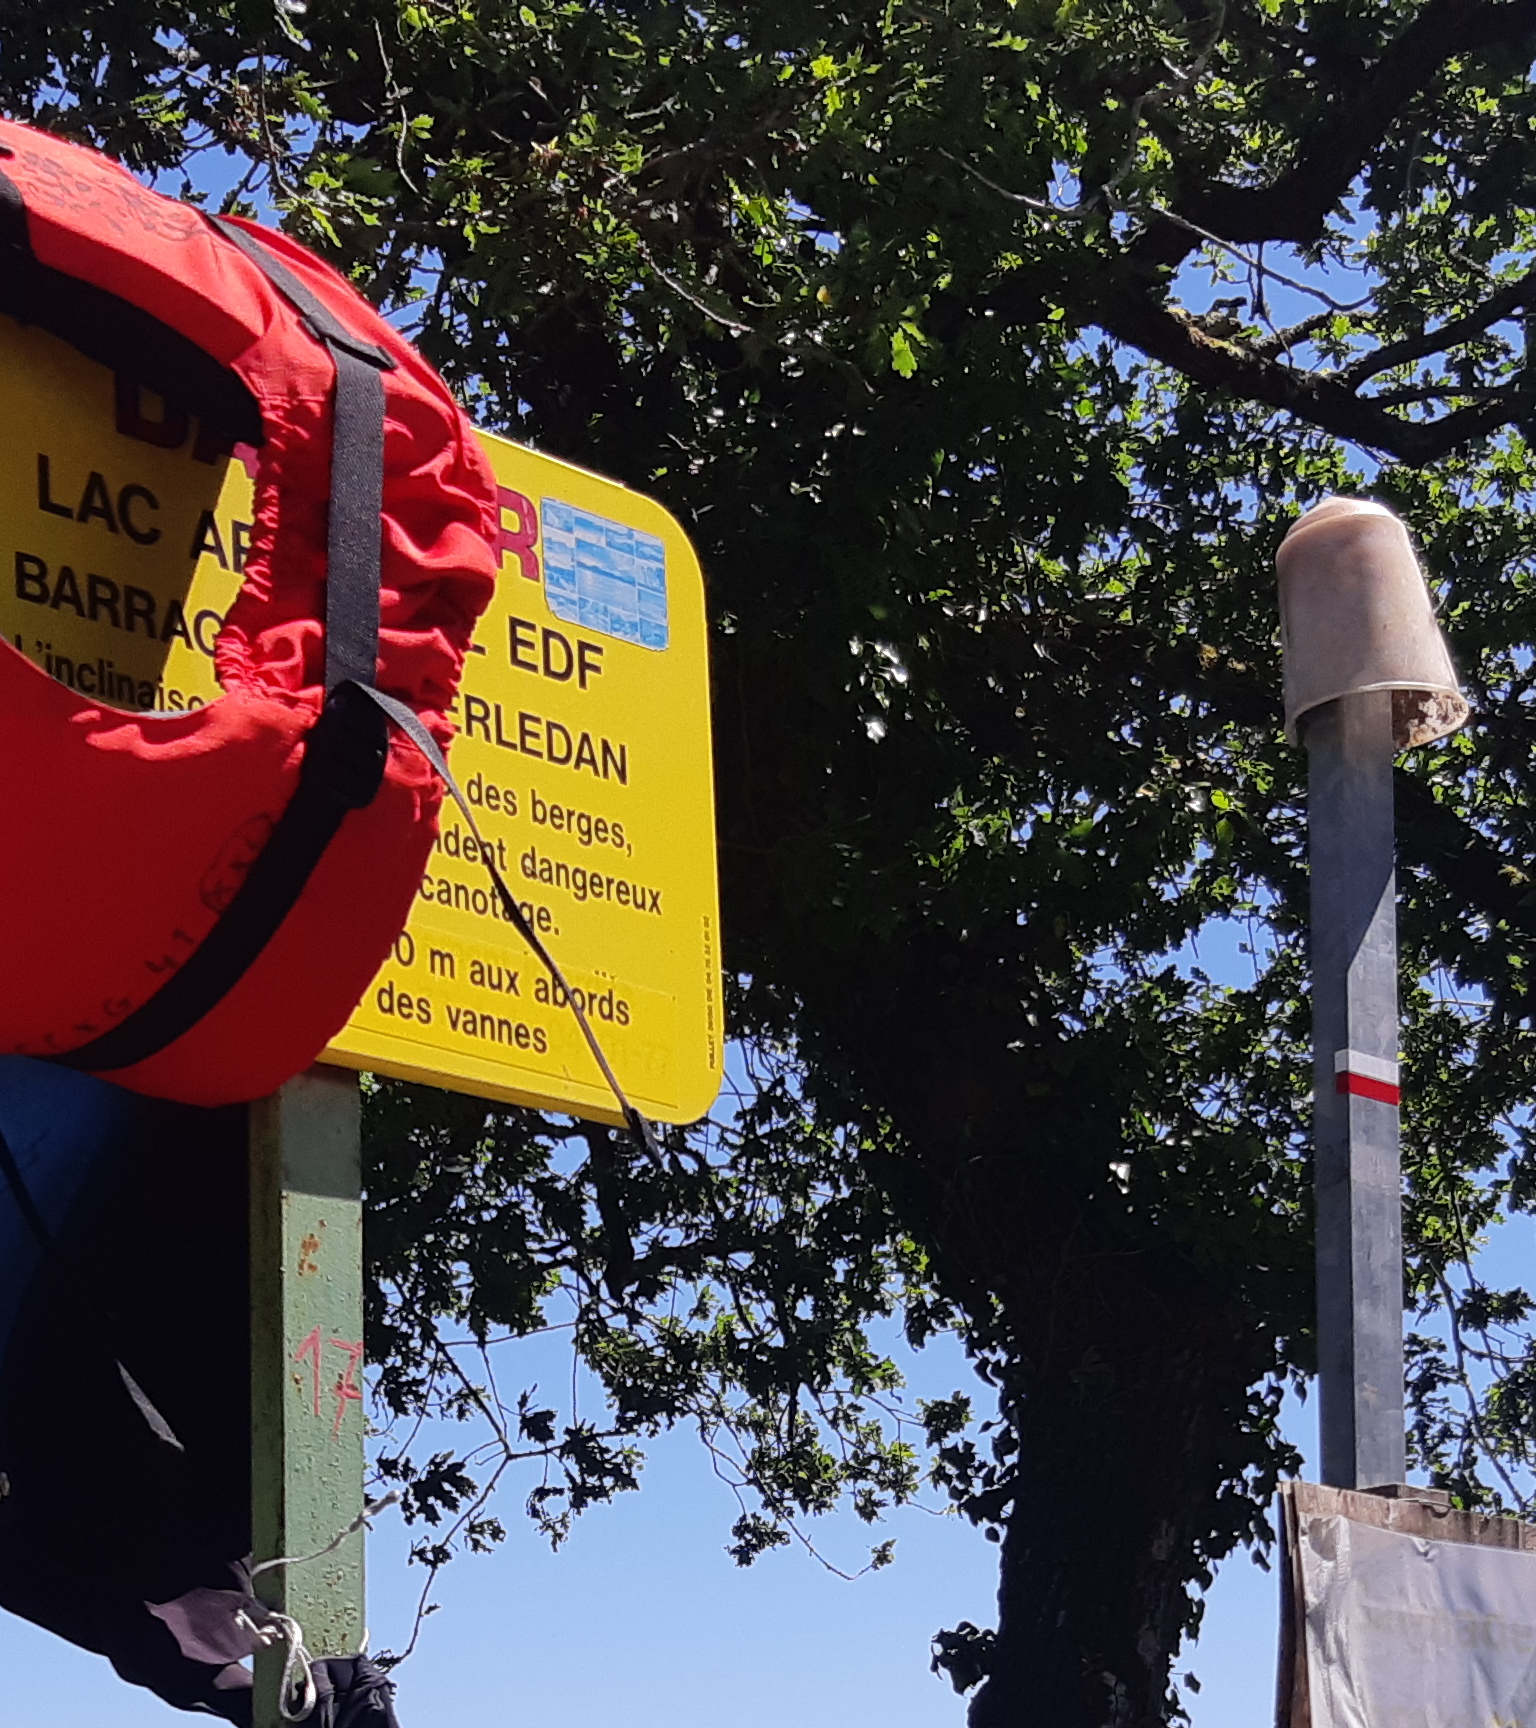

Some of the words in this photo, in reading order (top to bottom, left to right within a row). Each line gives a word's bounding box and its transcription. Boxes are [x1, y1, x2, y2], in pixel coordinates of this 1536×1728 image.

[37, 452, 162, 546] LAC
[14, 550, 225, 659] BARRAG
[508, 614, 604, 691] EDF
[445, 692, 628, 786] RLEDAN
[466, 772, 518, 816] des
[531, 788, 633, 858] berges,
[435, 823, 507, 872] dent
[521, 845, 662, 916] dangereux
[376, 980, 432, 1025] des
[446, 1003, 548, 1055] vannes
[429, 947, 456, 980] m
[469, 959, 521, 998] aux
[534, 975, 630, 1027] abords
